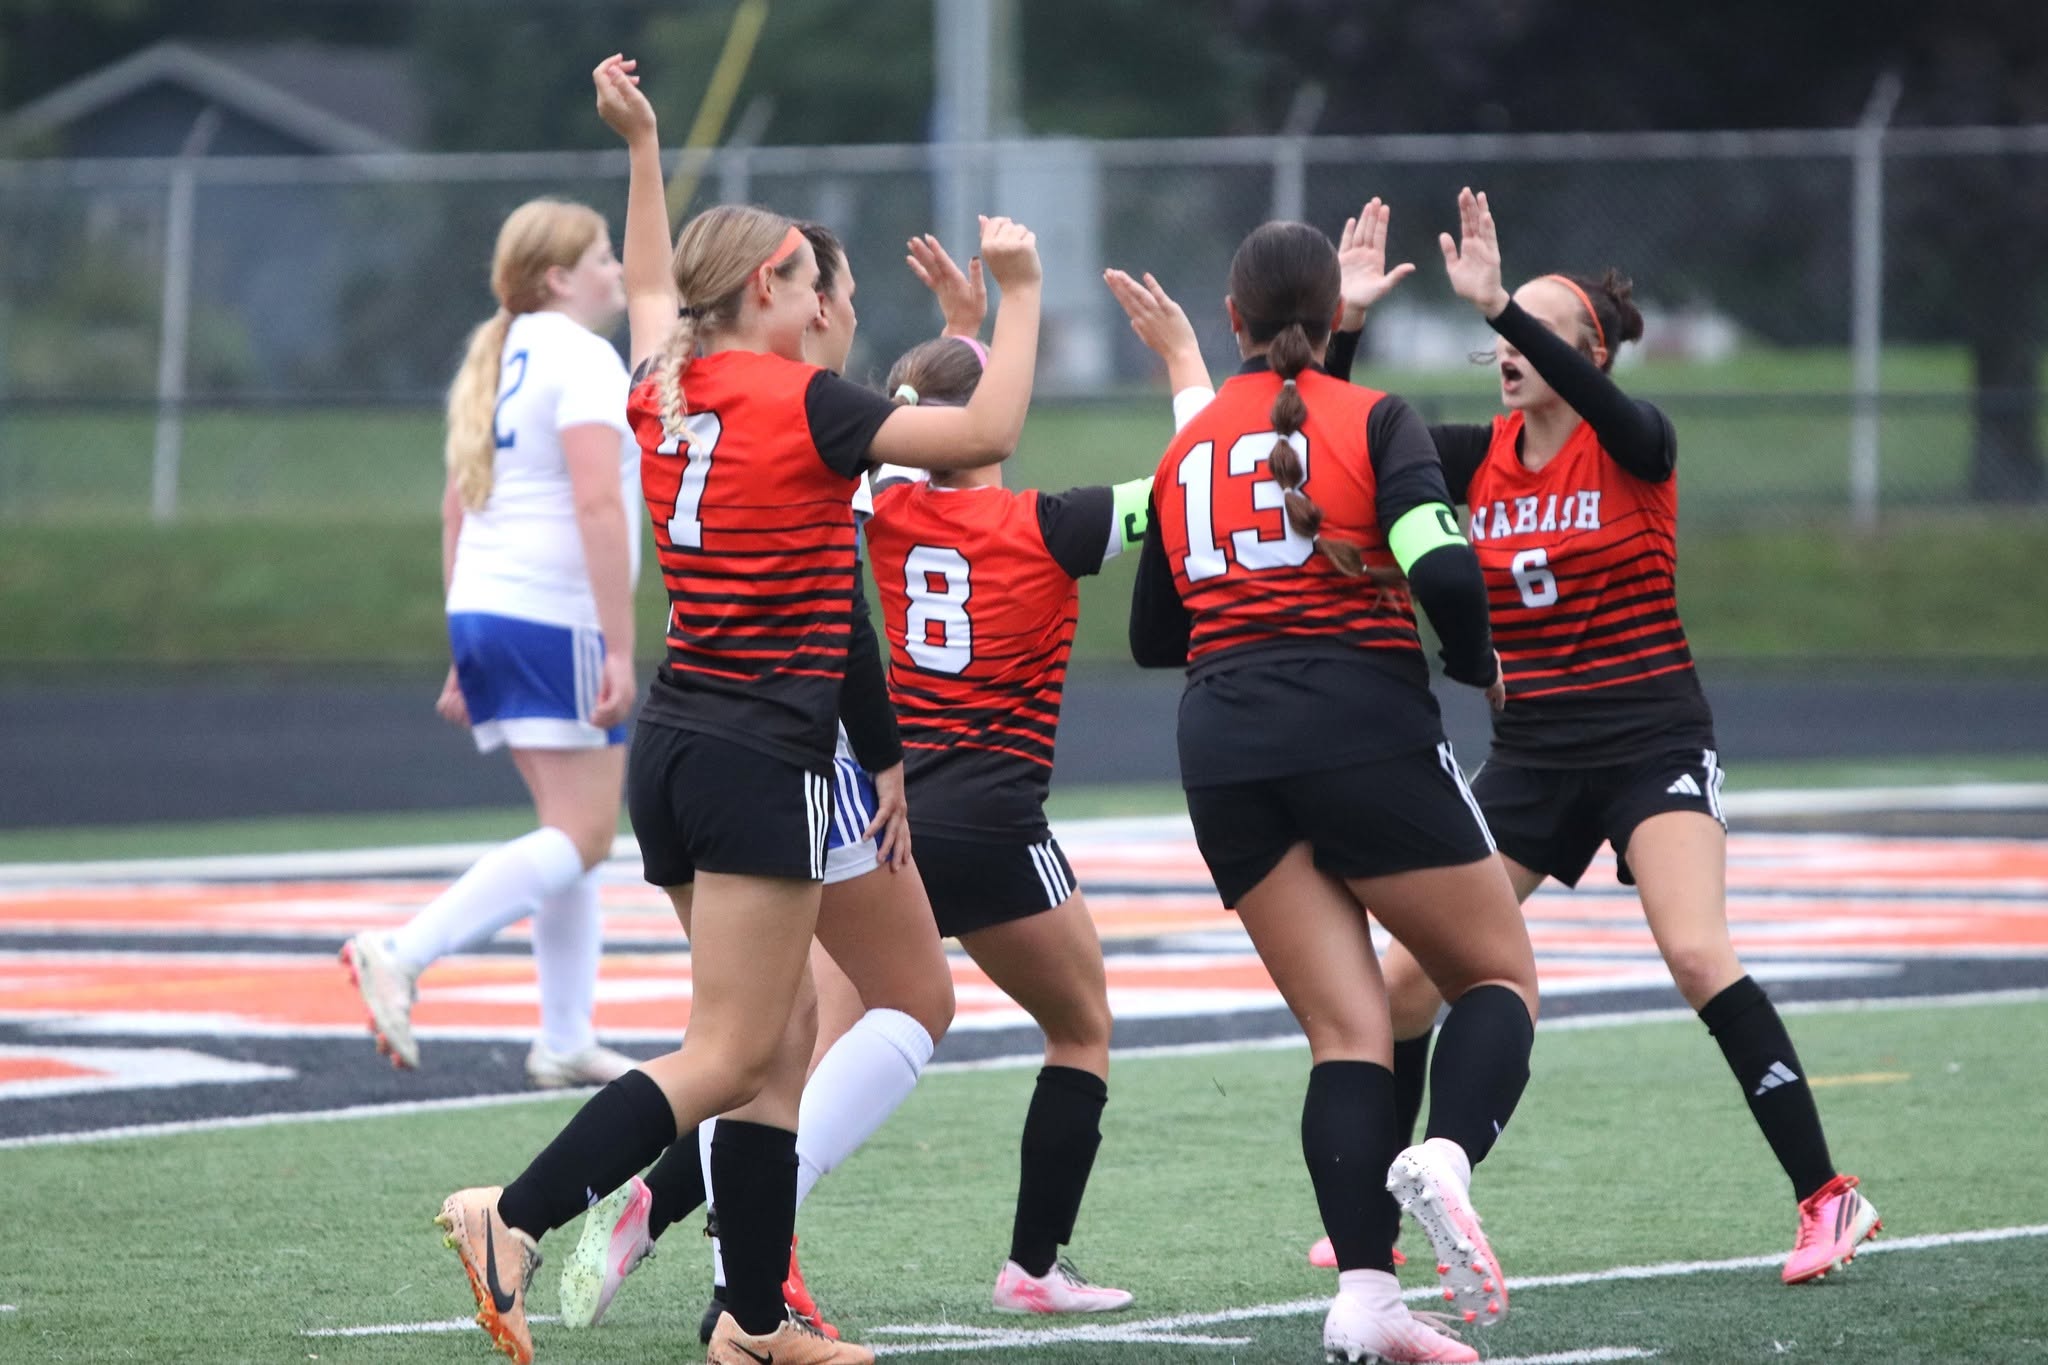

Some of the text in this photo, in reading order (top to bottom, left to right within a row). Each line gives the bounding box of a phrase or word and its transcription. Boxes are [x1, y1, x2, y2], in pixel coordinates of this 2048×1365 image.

[494, 350, 528, 449] 2
[656, 412, 722, 549] 7
[1178, 430, 1316, 583] 13
[904, 544, 973, 675] 8
[1511, 547, 1559, 608] 6
